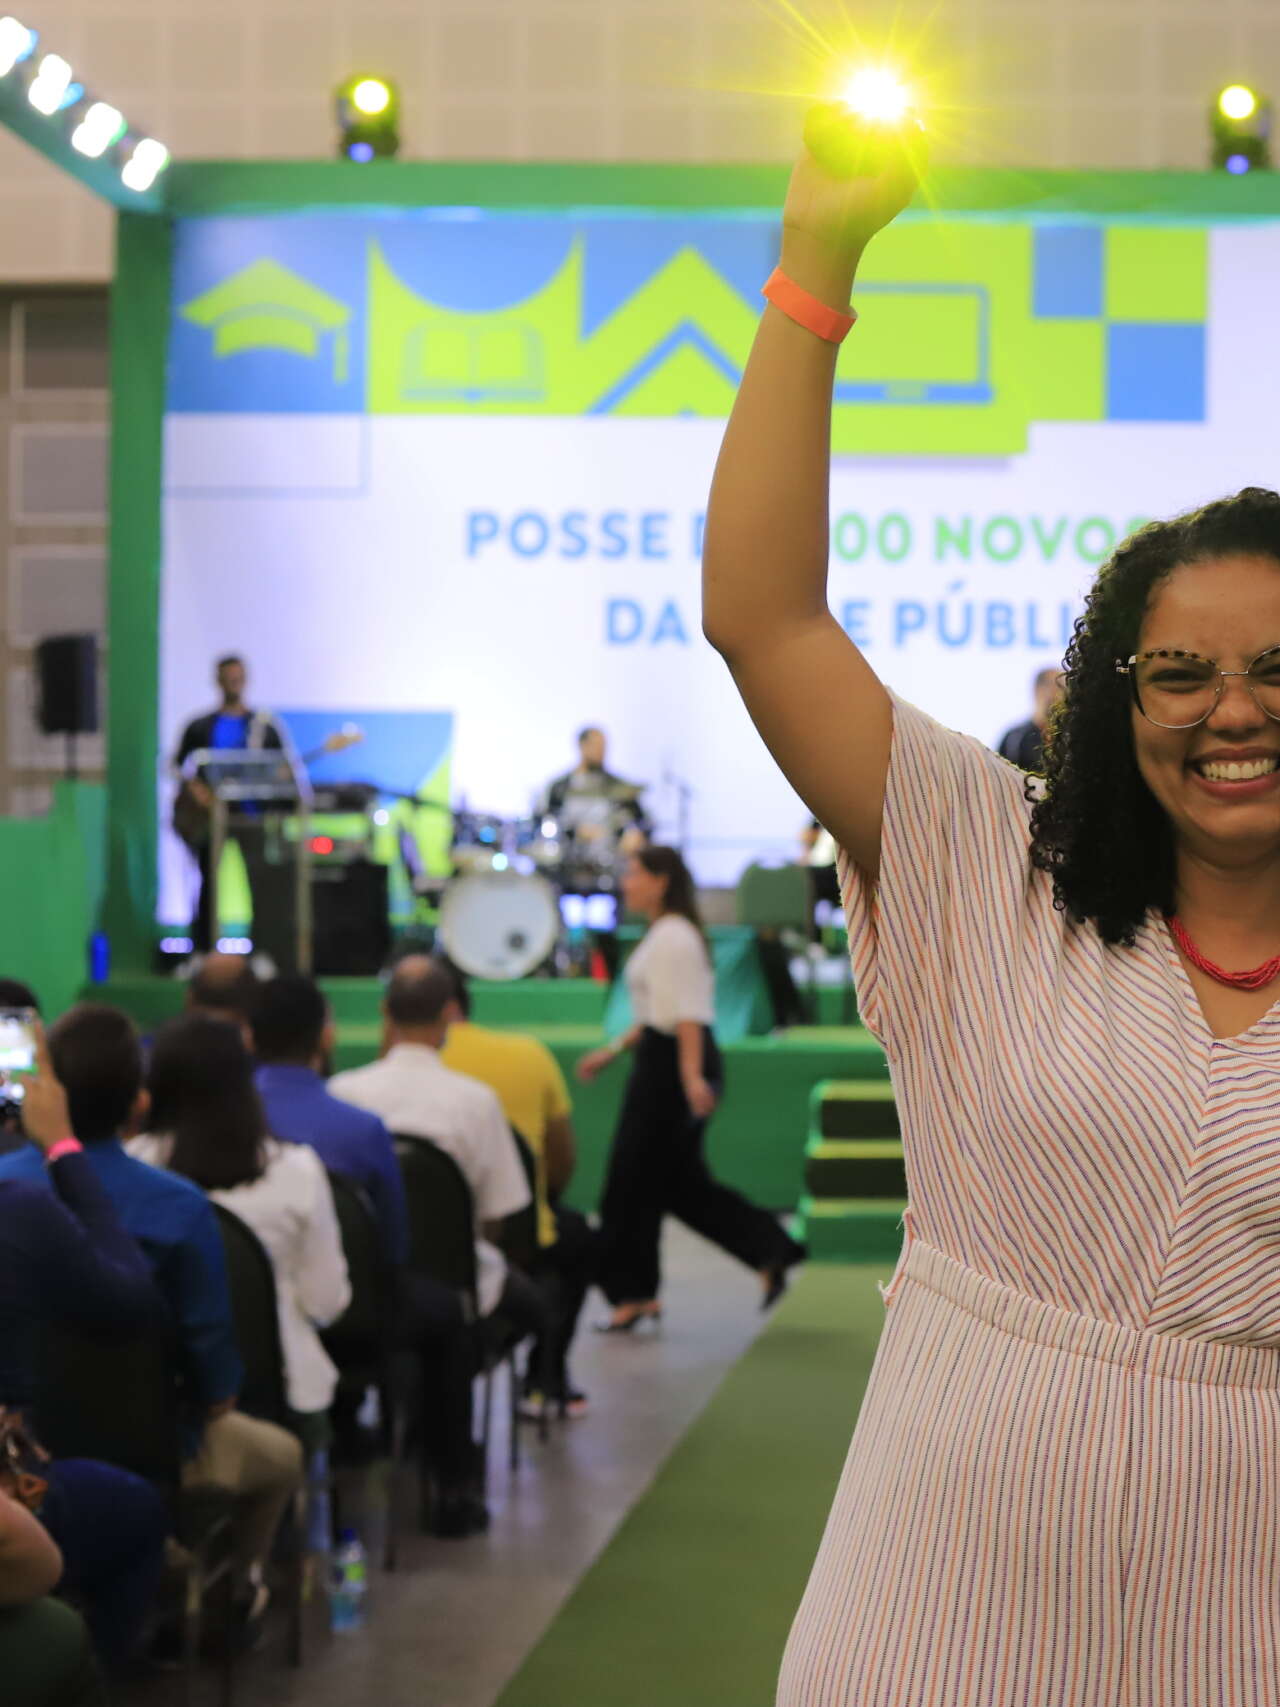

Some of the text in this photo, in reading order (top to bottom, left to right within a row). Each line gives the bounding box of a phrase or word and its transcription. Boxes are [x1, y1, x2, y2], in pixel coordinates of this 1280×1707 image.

[466, 511, 670, 560] POSSE
[829, 513, 911, 562] 00
[605, 598, 689, 647] DA
[893, 581, 1072, 649] PÚBLI
